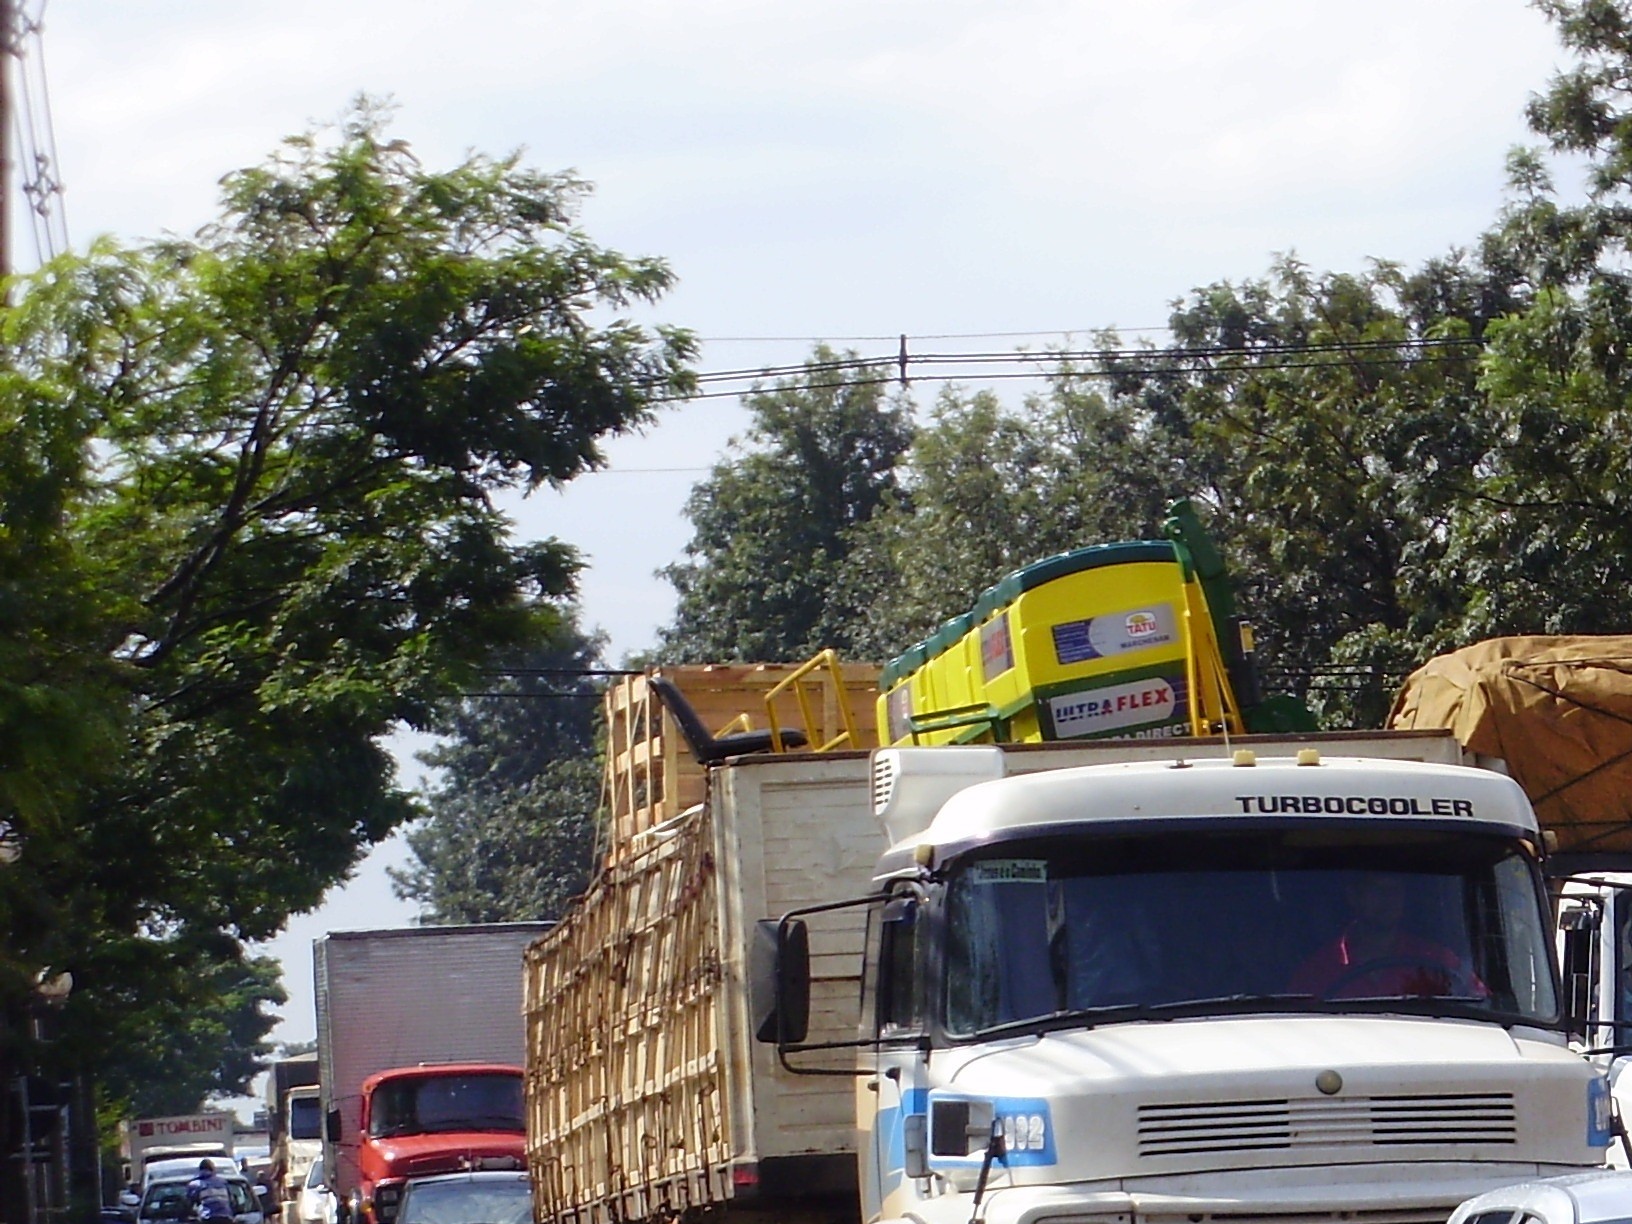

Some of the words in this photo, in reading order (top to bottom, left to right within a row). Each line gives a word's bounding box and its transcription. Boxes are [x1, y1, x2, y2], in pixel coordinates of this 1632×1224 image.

[1127, 619, 1156, 635] TATU
[1136, 722, 1192, 740] DIRECT
[1235, 796, 1474, 818] TURBOCOOLER
[157, 1119, 224, 1135] TOMBINI
